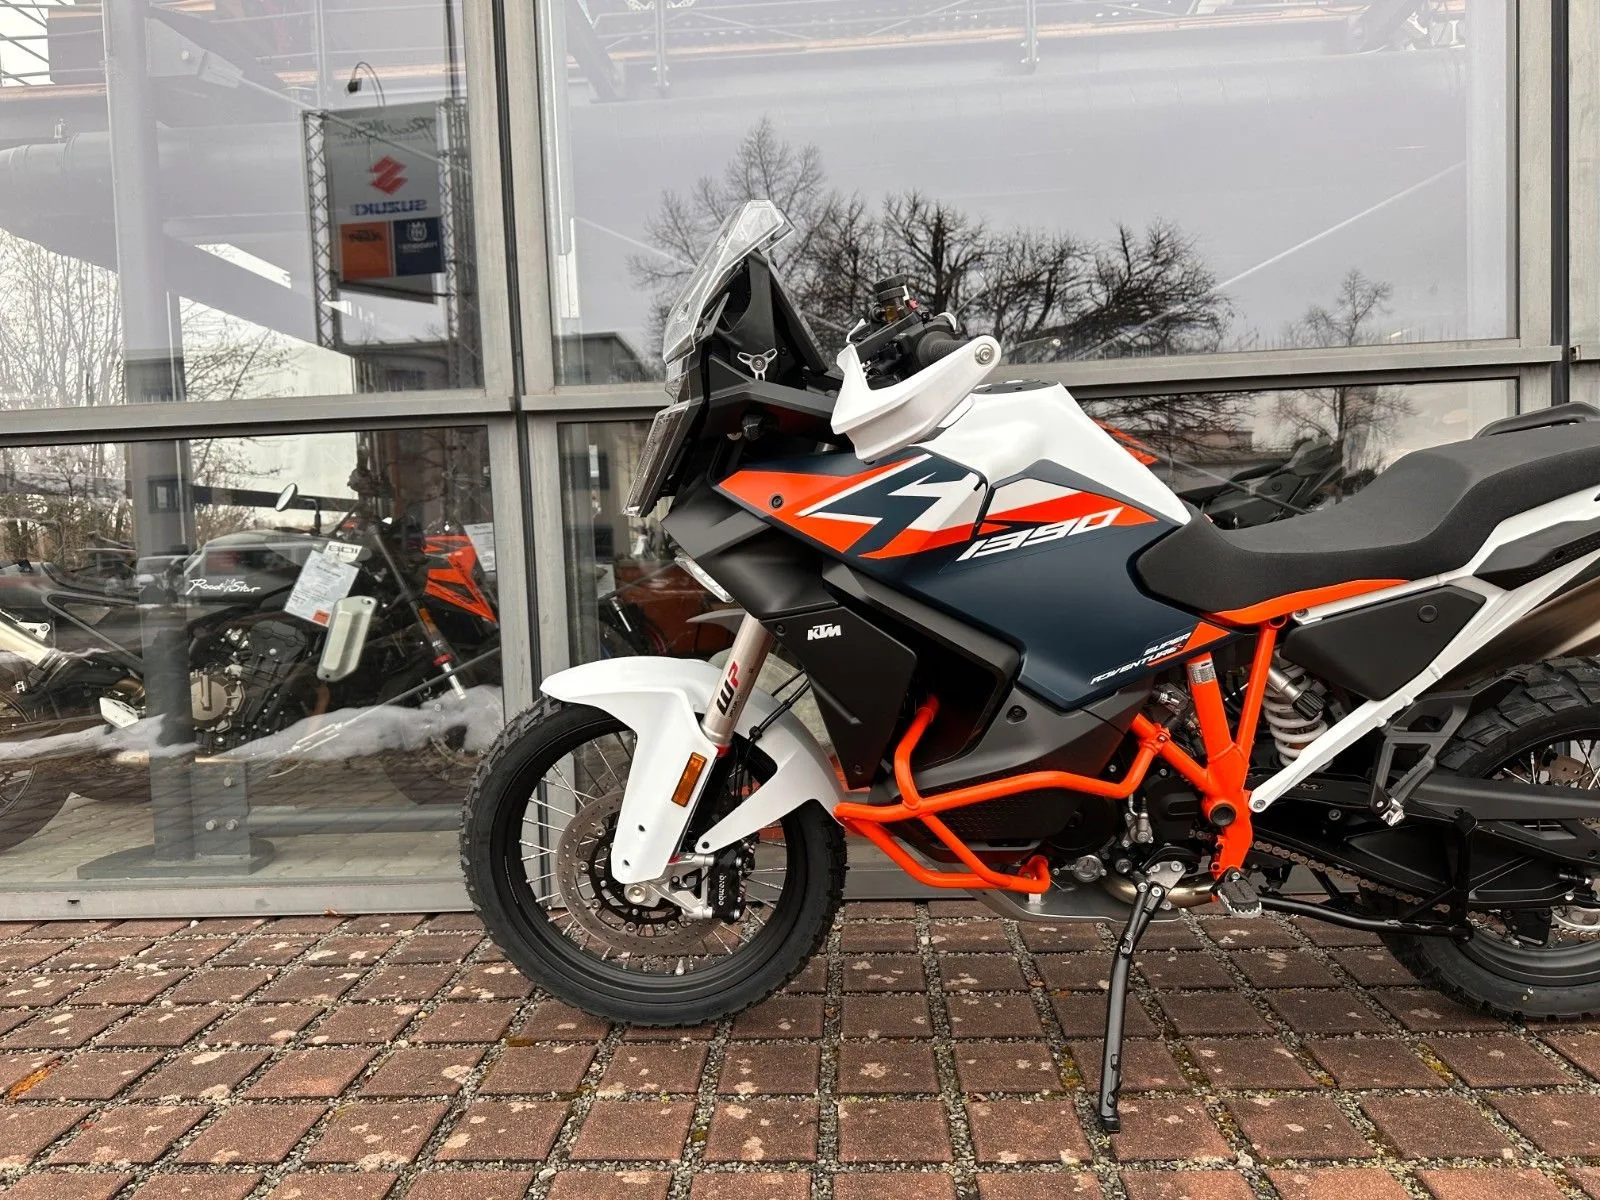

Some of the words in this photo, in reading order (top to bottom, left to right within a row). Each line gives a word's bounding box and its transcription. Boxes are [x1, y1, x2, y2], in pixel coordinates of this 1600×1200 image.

[956, 507, 1124, 561] 1390
[807, 623, 842, 641] KTM
[1143, 632, 1192, 656] SUPER
[1090, 647, 1178, 685] ADVENTURE
[716, 660, 739, 716] WP
[718, 874, 727, 906] brembo
